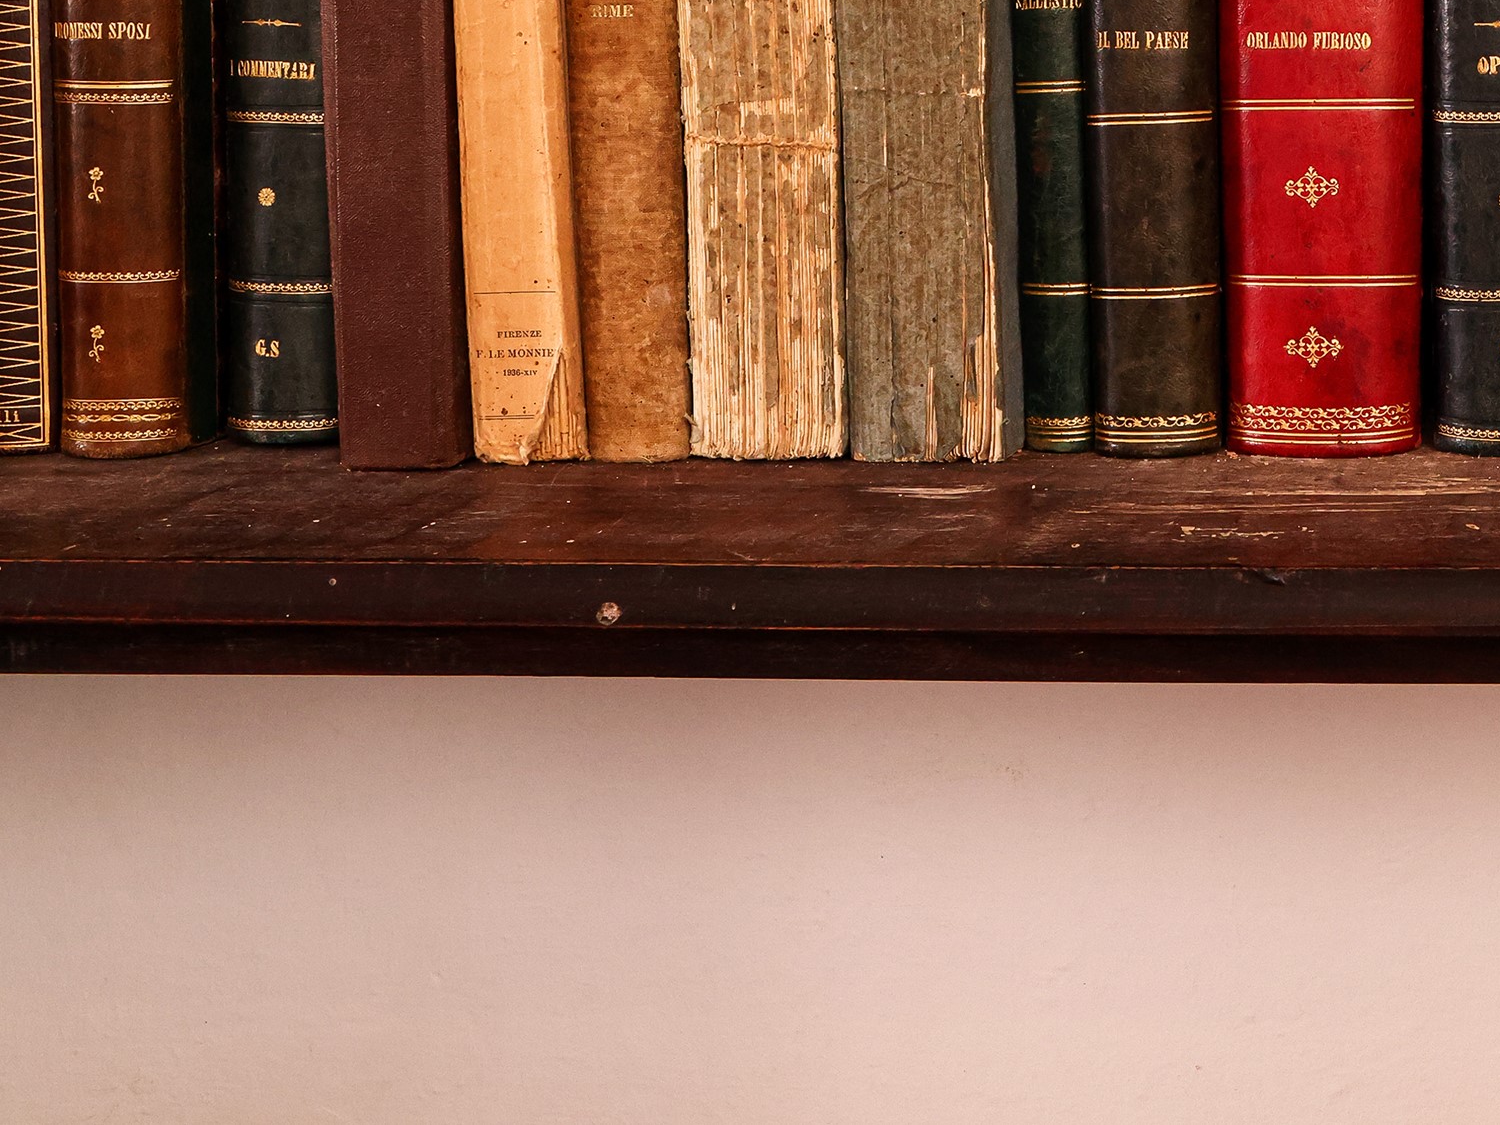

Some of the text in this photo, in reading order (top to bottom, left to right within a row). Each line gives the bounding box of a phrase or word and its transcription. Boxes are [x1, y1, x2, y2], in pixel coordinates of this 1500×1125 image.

[591, 4, 634, 18] RIME
[108, 22, 152, 40] SPOSI
[1115, 30, 1140, 49] BEL
[1145, 30, 1189, 50] PAESE
[1246, 31, 1371, 50] ORLANDO FURIOSO
[237, 59, 316, 80] COMMENTARI
[497, 330, 542, 339] FIRENZE
[476, 348, 554, 358] F. LE MONNIE
